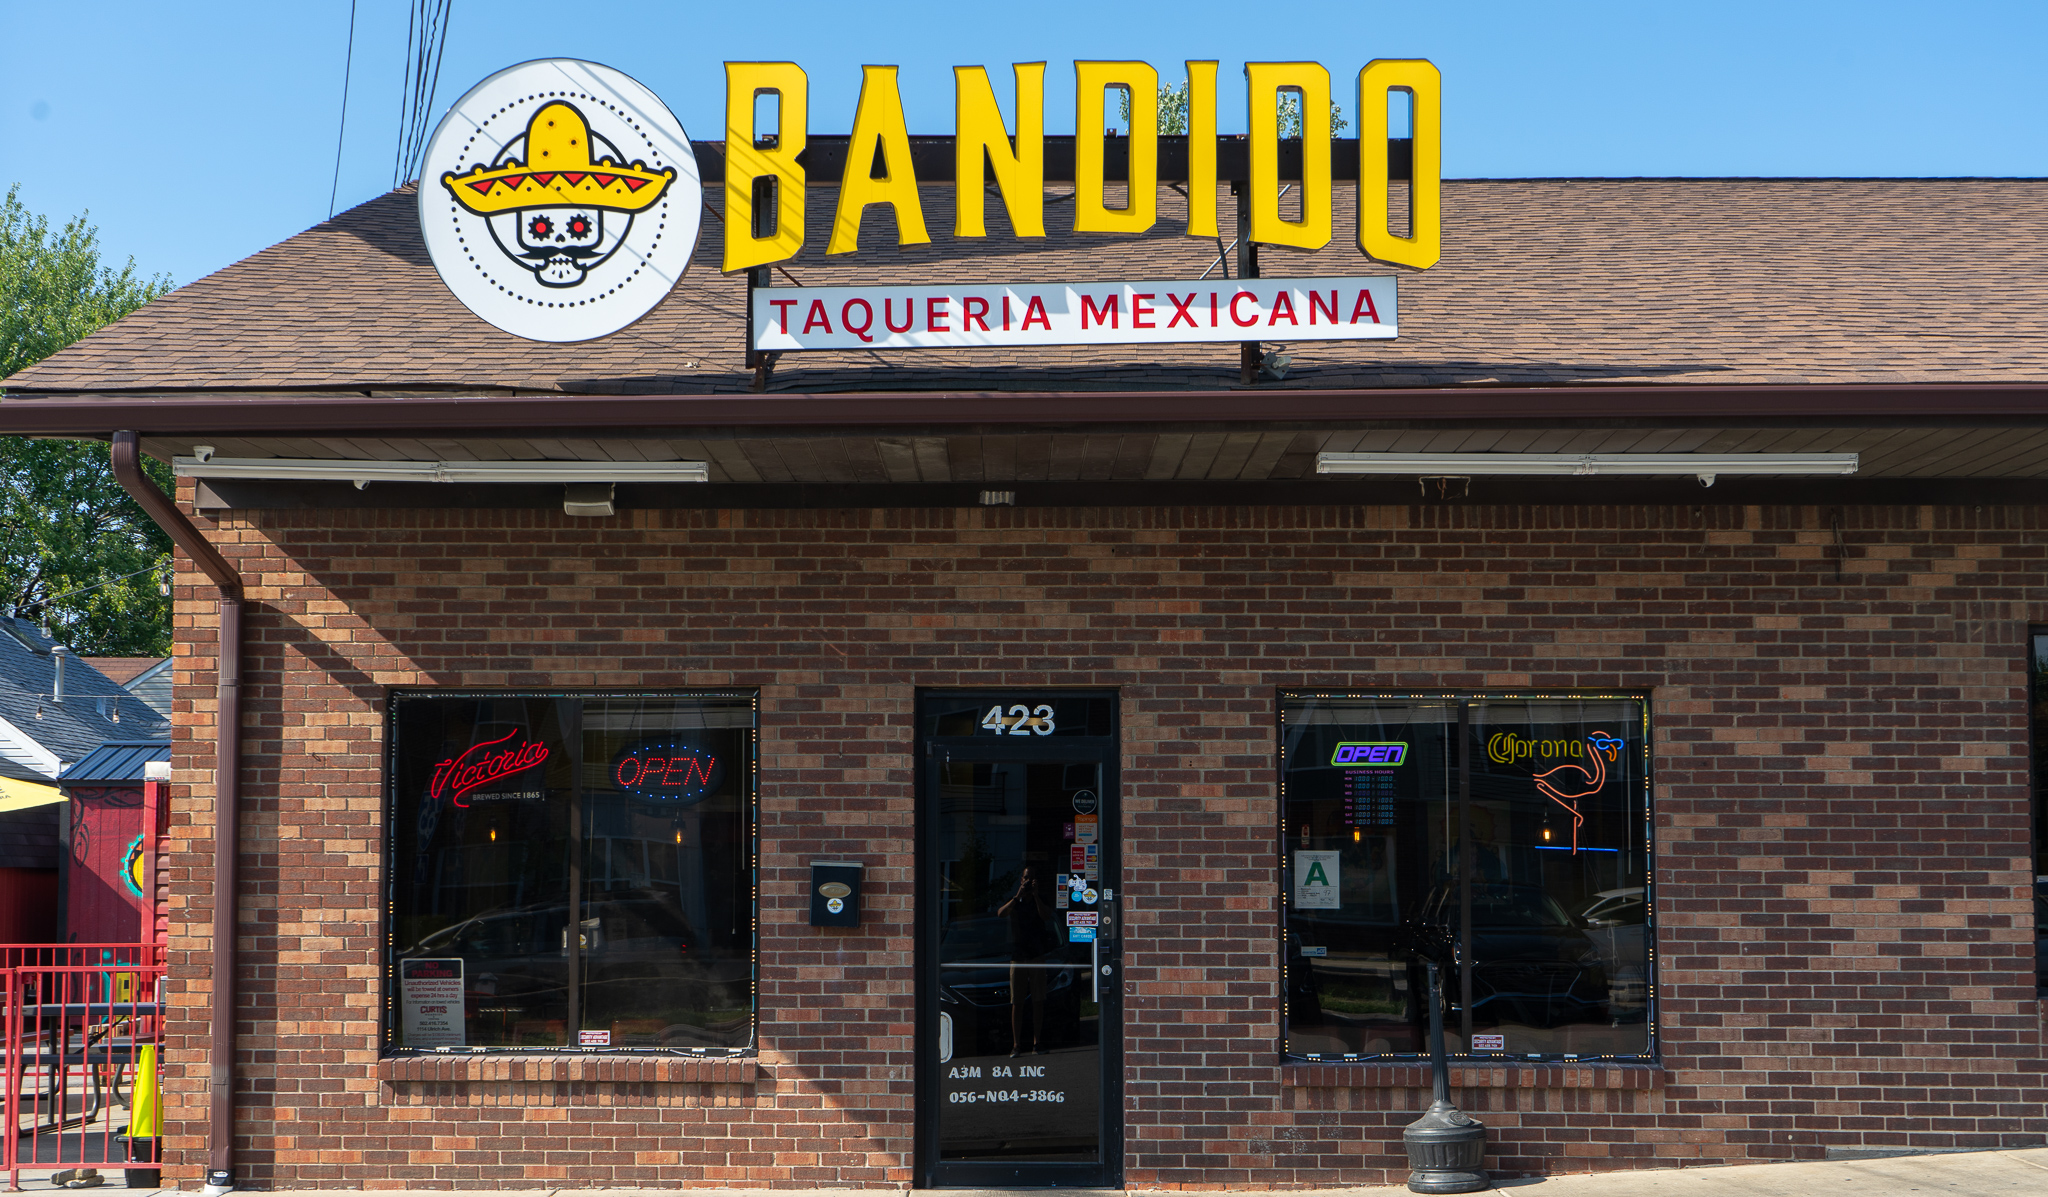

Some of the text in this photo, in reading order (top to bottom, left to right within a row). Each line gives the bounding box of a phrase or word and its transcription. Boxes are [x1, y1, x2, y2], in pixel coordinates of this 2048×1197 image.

[720, 57, 1441, 273] BANDIDO
[770, 288, 1382, 340] TAQUERIA MEXICANA
[981, 704, 1056, 736] 423
[1336, 746, 1404, 762] OPEN
[1488, 732, 1583, 764] Corona
[431, 728, 549, 808] Victoria
[617, 757, 716, 786] OPEN
[472, 791, 540, 801] BREWED SINCE 1865
[1304, 861, 1330, 886] A
[420, 1005, 447, 1014] CURTIS
[992, 1066, 1013, 1077] 8A
[1019, 1065, 1046, 1078] INC
